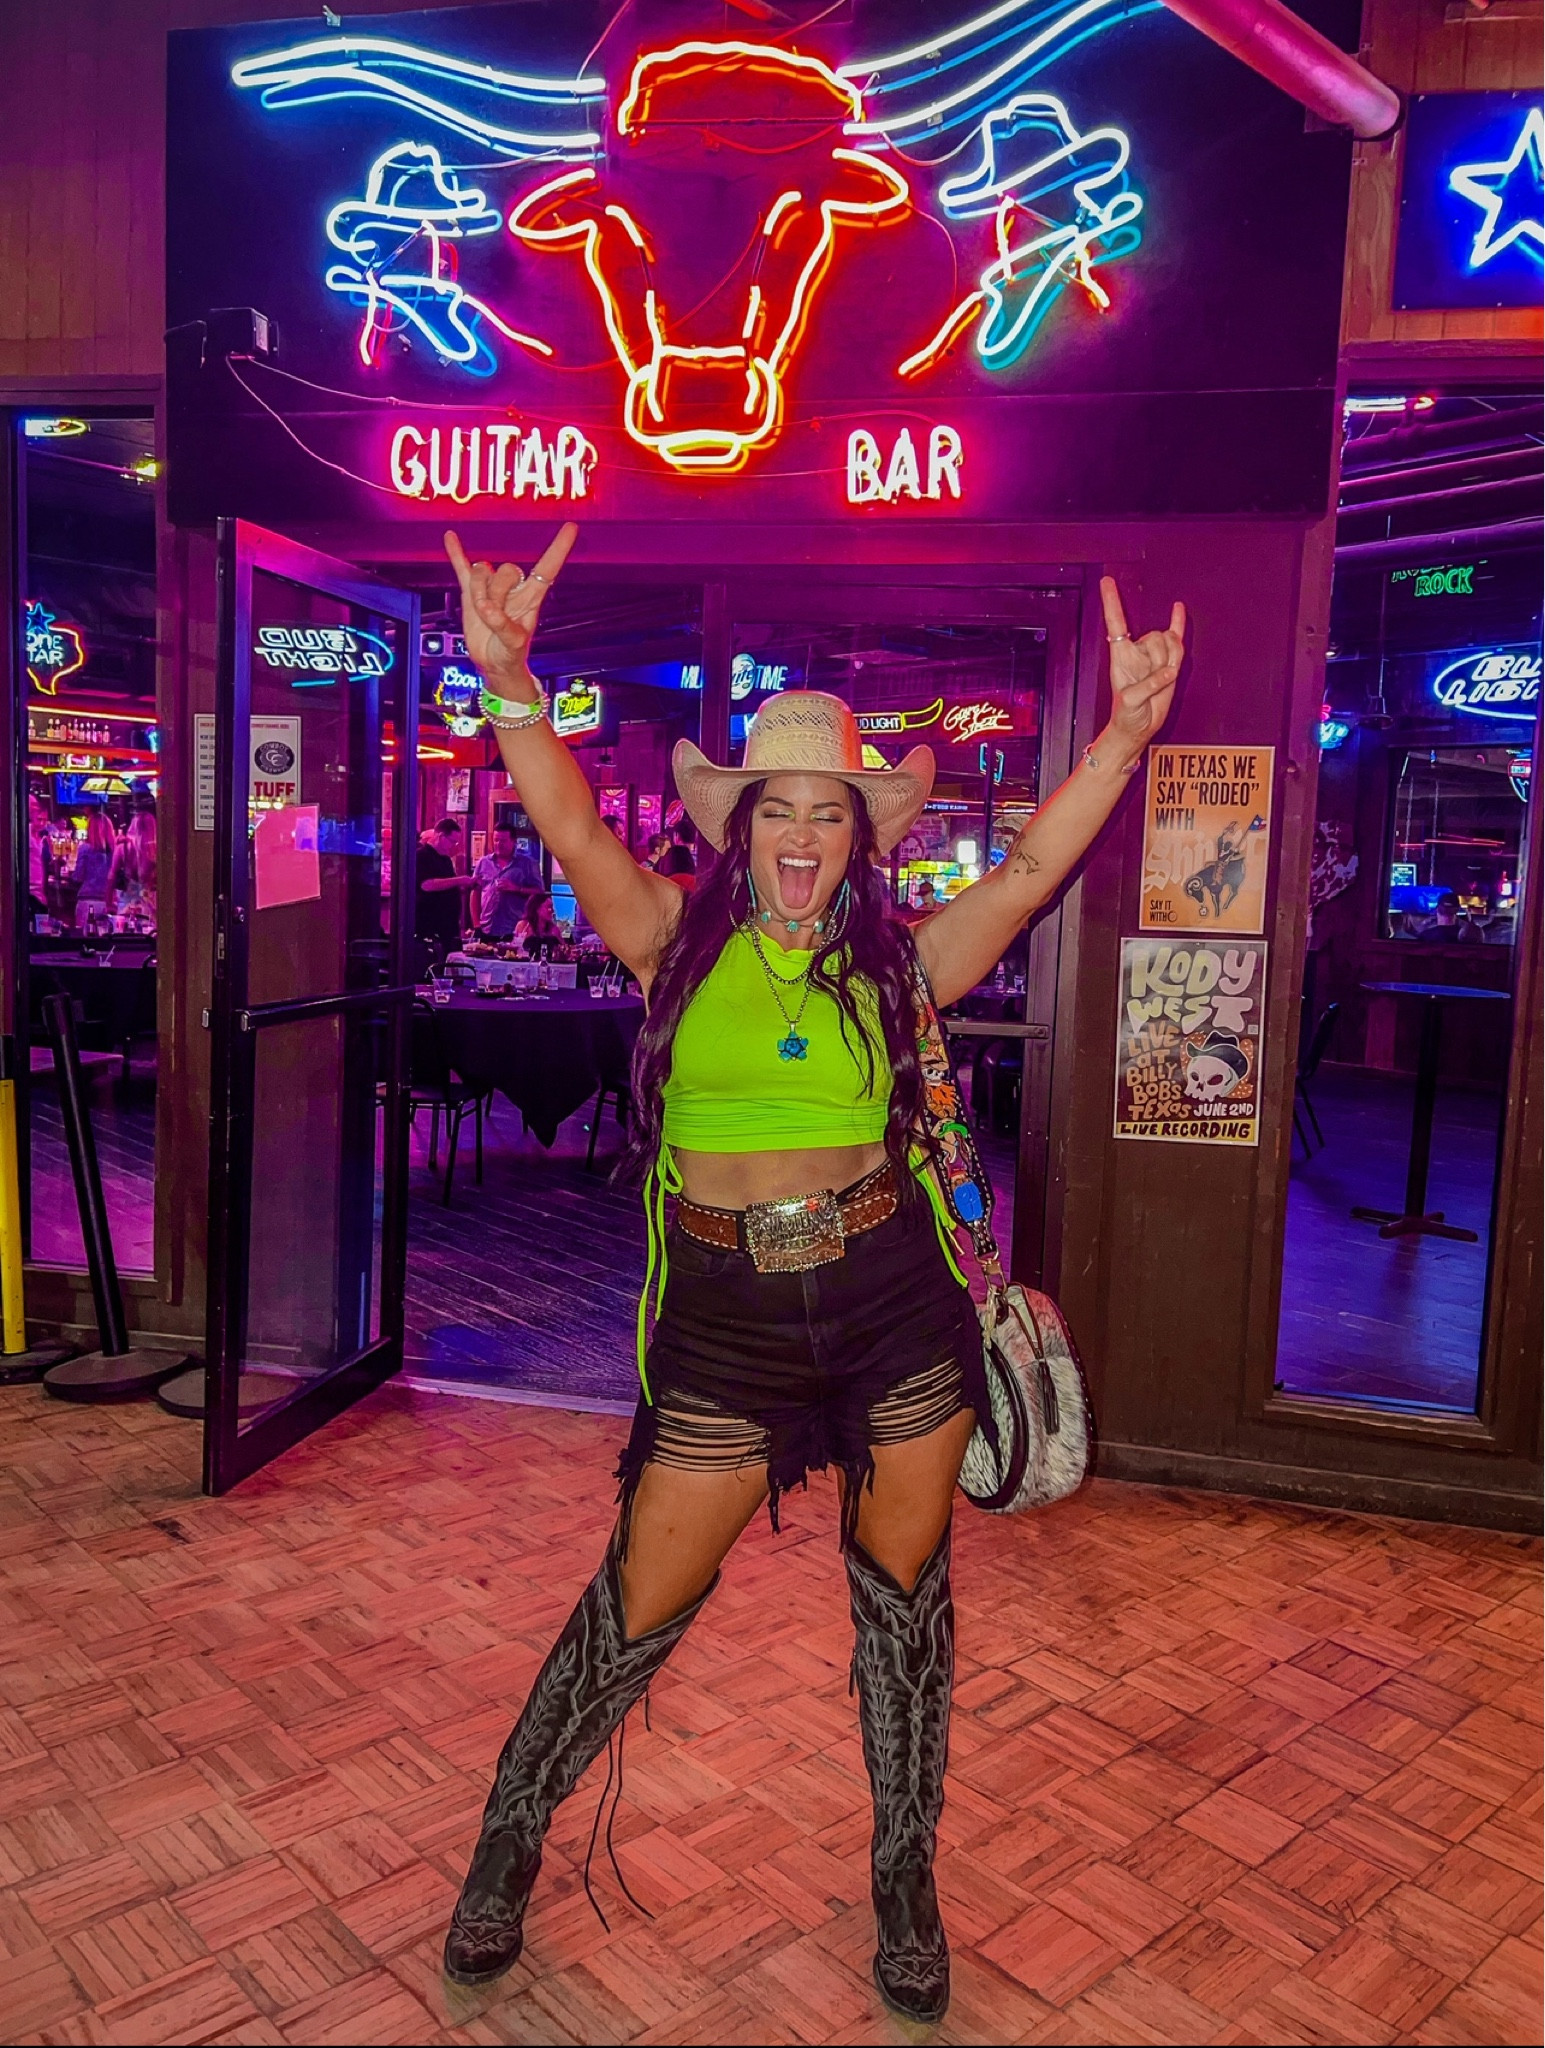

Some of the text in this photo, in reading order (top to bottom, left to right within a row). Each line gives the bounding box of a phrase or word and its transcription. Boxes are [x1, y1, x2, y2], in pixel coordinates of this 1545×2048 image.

[391, 425, 962, 502] GUITAR BAR
[1414, 566, 1473, 596] ROCK
[26, 648, 63, 666] TAR
[855, 717, 900, 730] UD LIGHT
[1158, 754, 1257, 779] IN TEXAS WE
[254, 781, 296, 797] TUFF
[1156, 781, 1187, 805] SAY
[1155, 807, 1195, 831] WITH
[1149, 911, 1168, 922] WITH
[1150, 899, 1172, 911] SAY IT
[1127, 995, 1253, 1035] WEST
[1128, 1020, 1181, 1057] LIVE
[1126, 1062, 1178, 1087] BILLY
[1193, 1101, 1228, 1117] JUNE
[1229, 1102, 1254, 1117] 2ND
[1120, 1122, 1251, 1139] LIVE RECORDING
